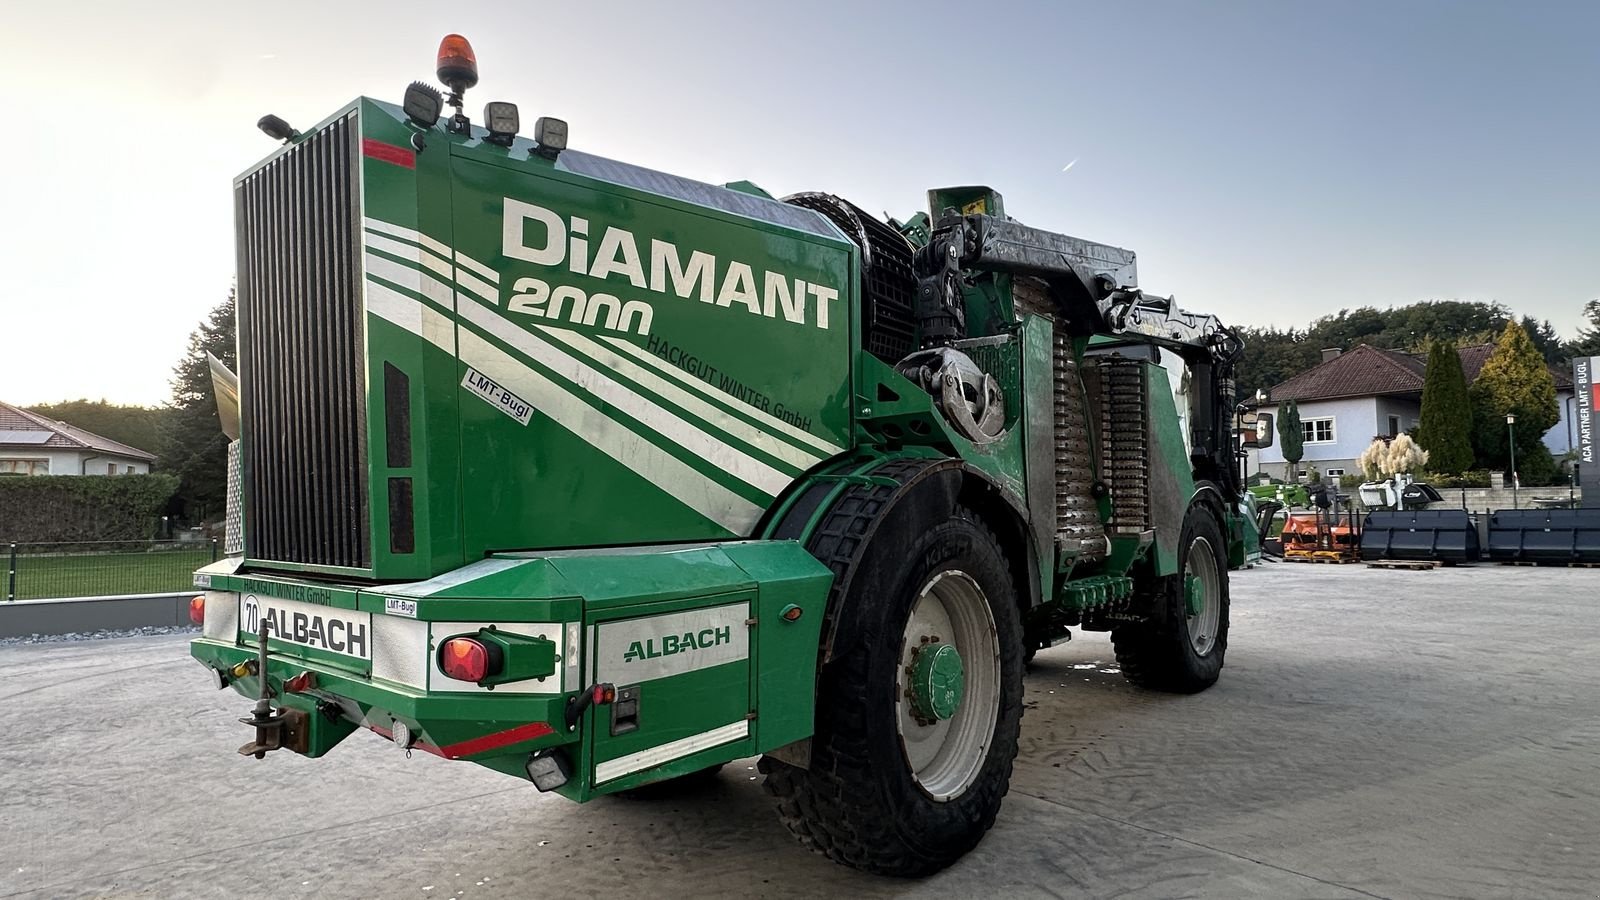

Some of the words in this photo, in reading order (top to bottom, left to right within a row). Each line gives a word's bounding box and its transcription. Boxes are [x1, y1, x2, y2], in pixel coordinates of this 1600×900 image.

[507, 277, 654, 336] 2000
[647, 333, 718, 385] HACKGUT
[719, 372, 769, 414] WINTER
[773, 403, 812, 433] GmbH
[1577, 361, 1588, 384] BUGL
[468, 371, 530, 418] LMT-Bugl
[1578, 390, 1589, 407] LMT
[1580, 407, 1591, 444] PARTNER
[1582, 445, 1593, 463] ACA
[244, 579, 276, 596] HACKGUT
[277, 583, 305, 601] WINTER
[306, 587, 332, 607] GmbH
[387, 600, 416, 614] LMT-Bugl
[246, 602, 258, 634] 70
[265, 607, 366, 658] ALBACH
[623, 625, 730, 663] ALBACH
